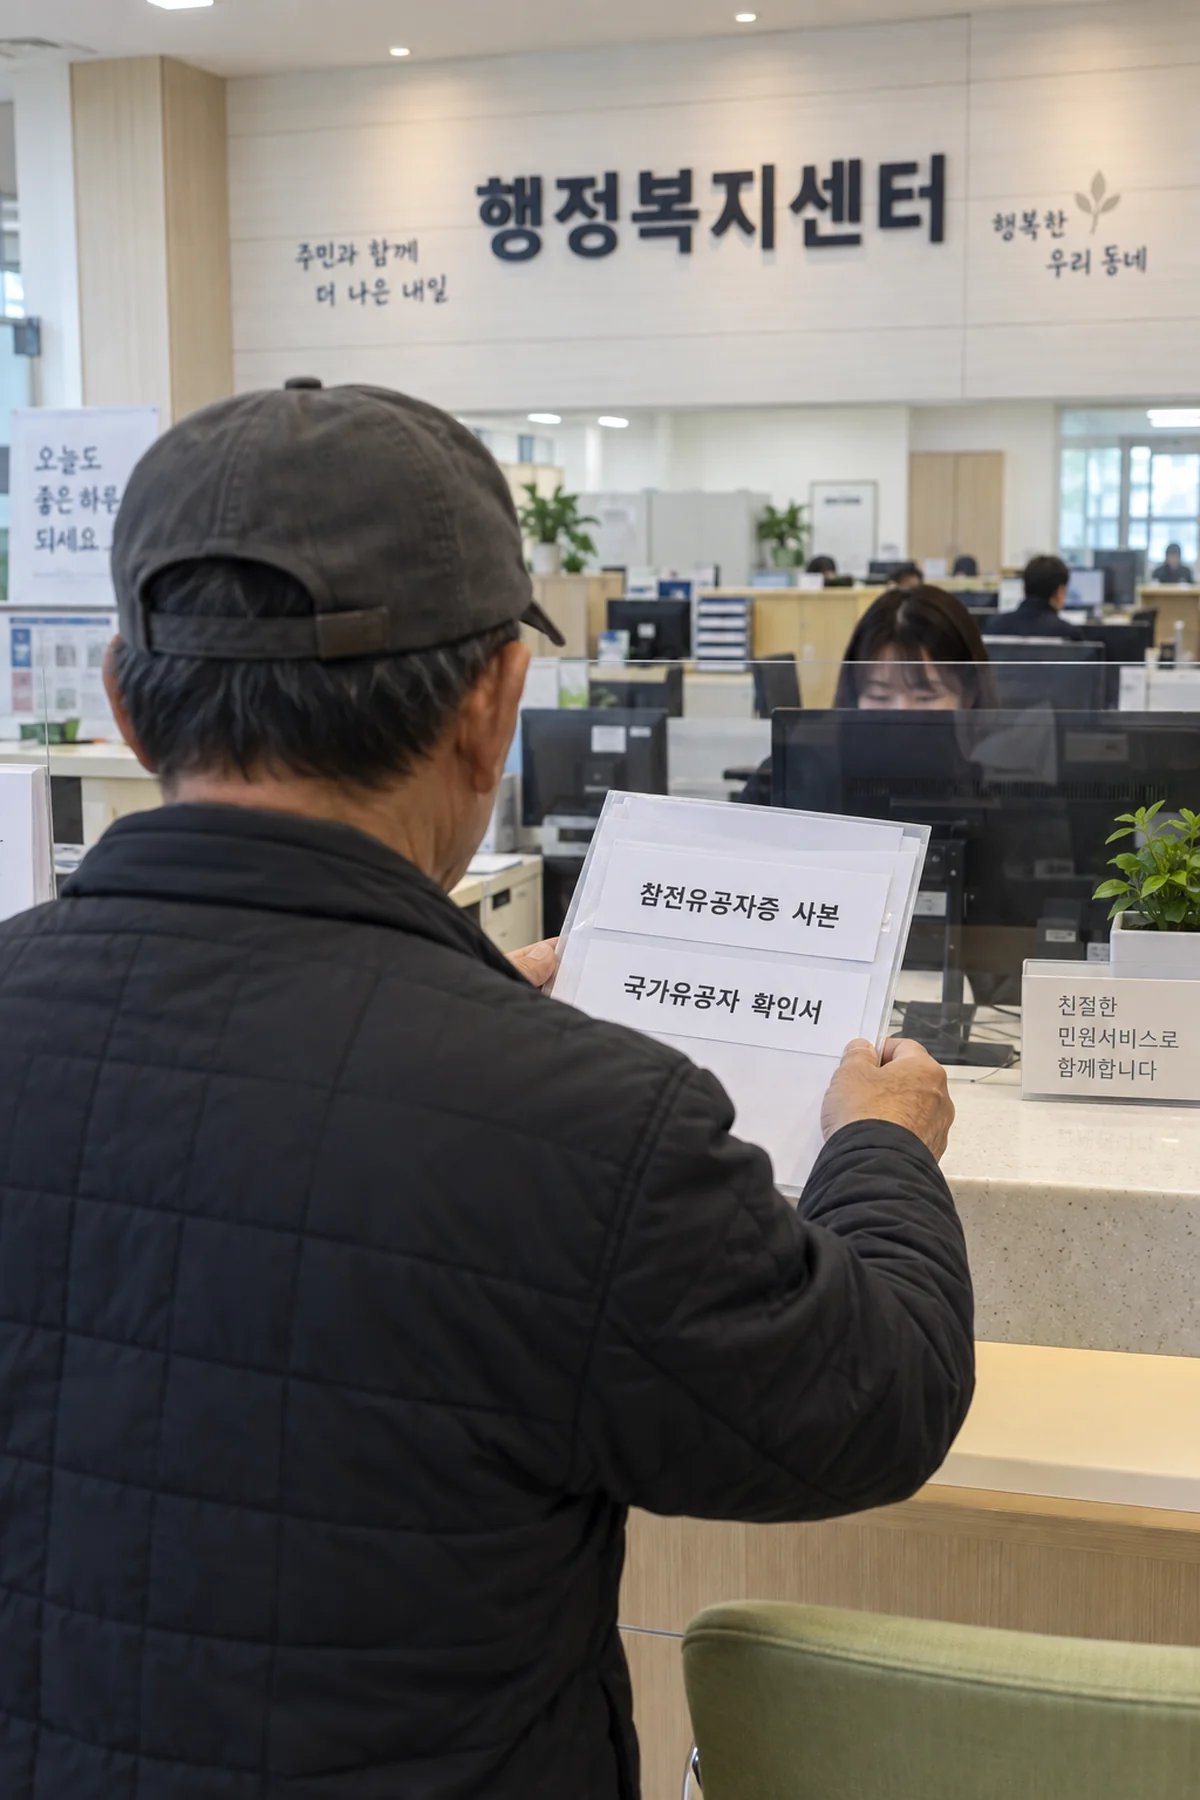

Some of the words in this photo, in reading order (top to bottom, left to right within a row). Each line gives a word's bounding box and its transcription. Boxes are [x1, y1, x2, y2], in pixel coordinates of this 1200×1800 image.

[476, 152, 948, 263] 행정복지센터
[992, 208, 1067, 243] 행복한
[295, 241, 359, 272] 주민과
[368, 238, 419, 267] 함께
[1046, 247, 1092, 279] 우리
[1101, 244, 1148, 277] 동네
[316, 282, 336, 308] 더
[347, 278, 391, 307] 나은
[402, 274, 449, 304] 내일
[34, 444, 102, 476] 오늘도
[35, 485, 74, 516] 좋은
[639, 881, 780, 922] 참전유공자증
[791, 901, 841, 930] 사본
[623, 974, 741, 1014] 국가유공자
[751, 992, 824, 1026] 확인서
[1057, 994, 1119, 1018] 친절한
[1057, 1026, 1180, 1050] 민원서비스로
[1056, 1056, 1159, 1082] 함께합니다
